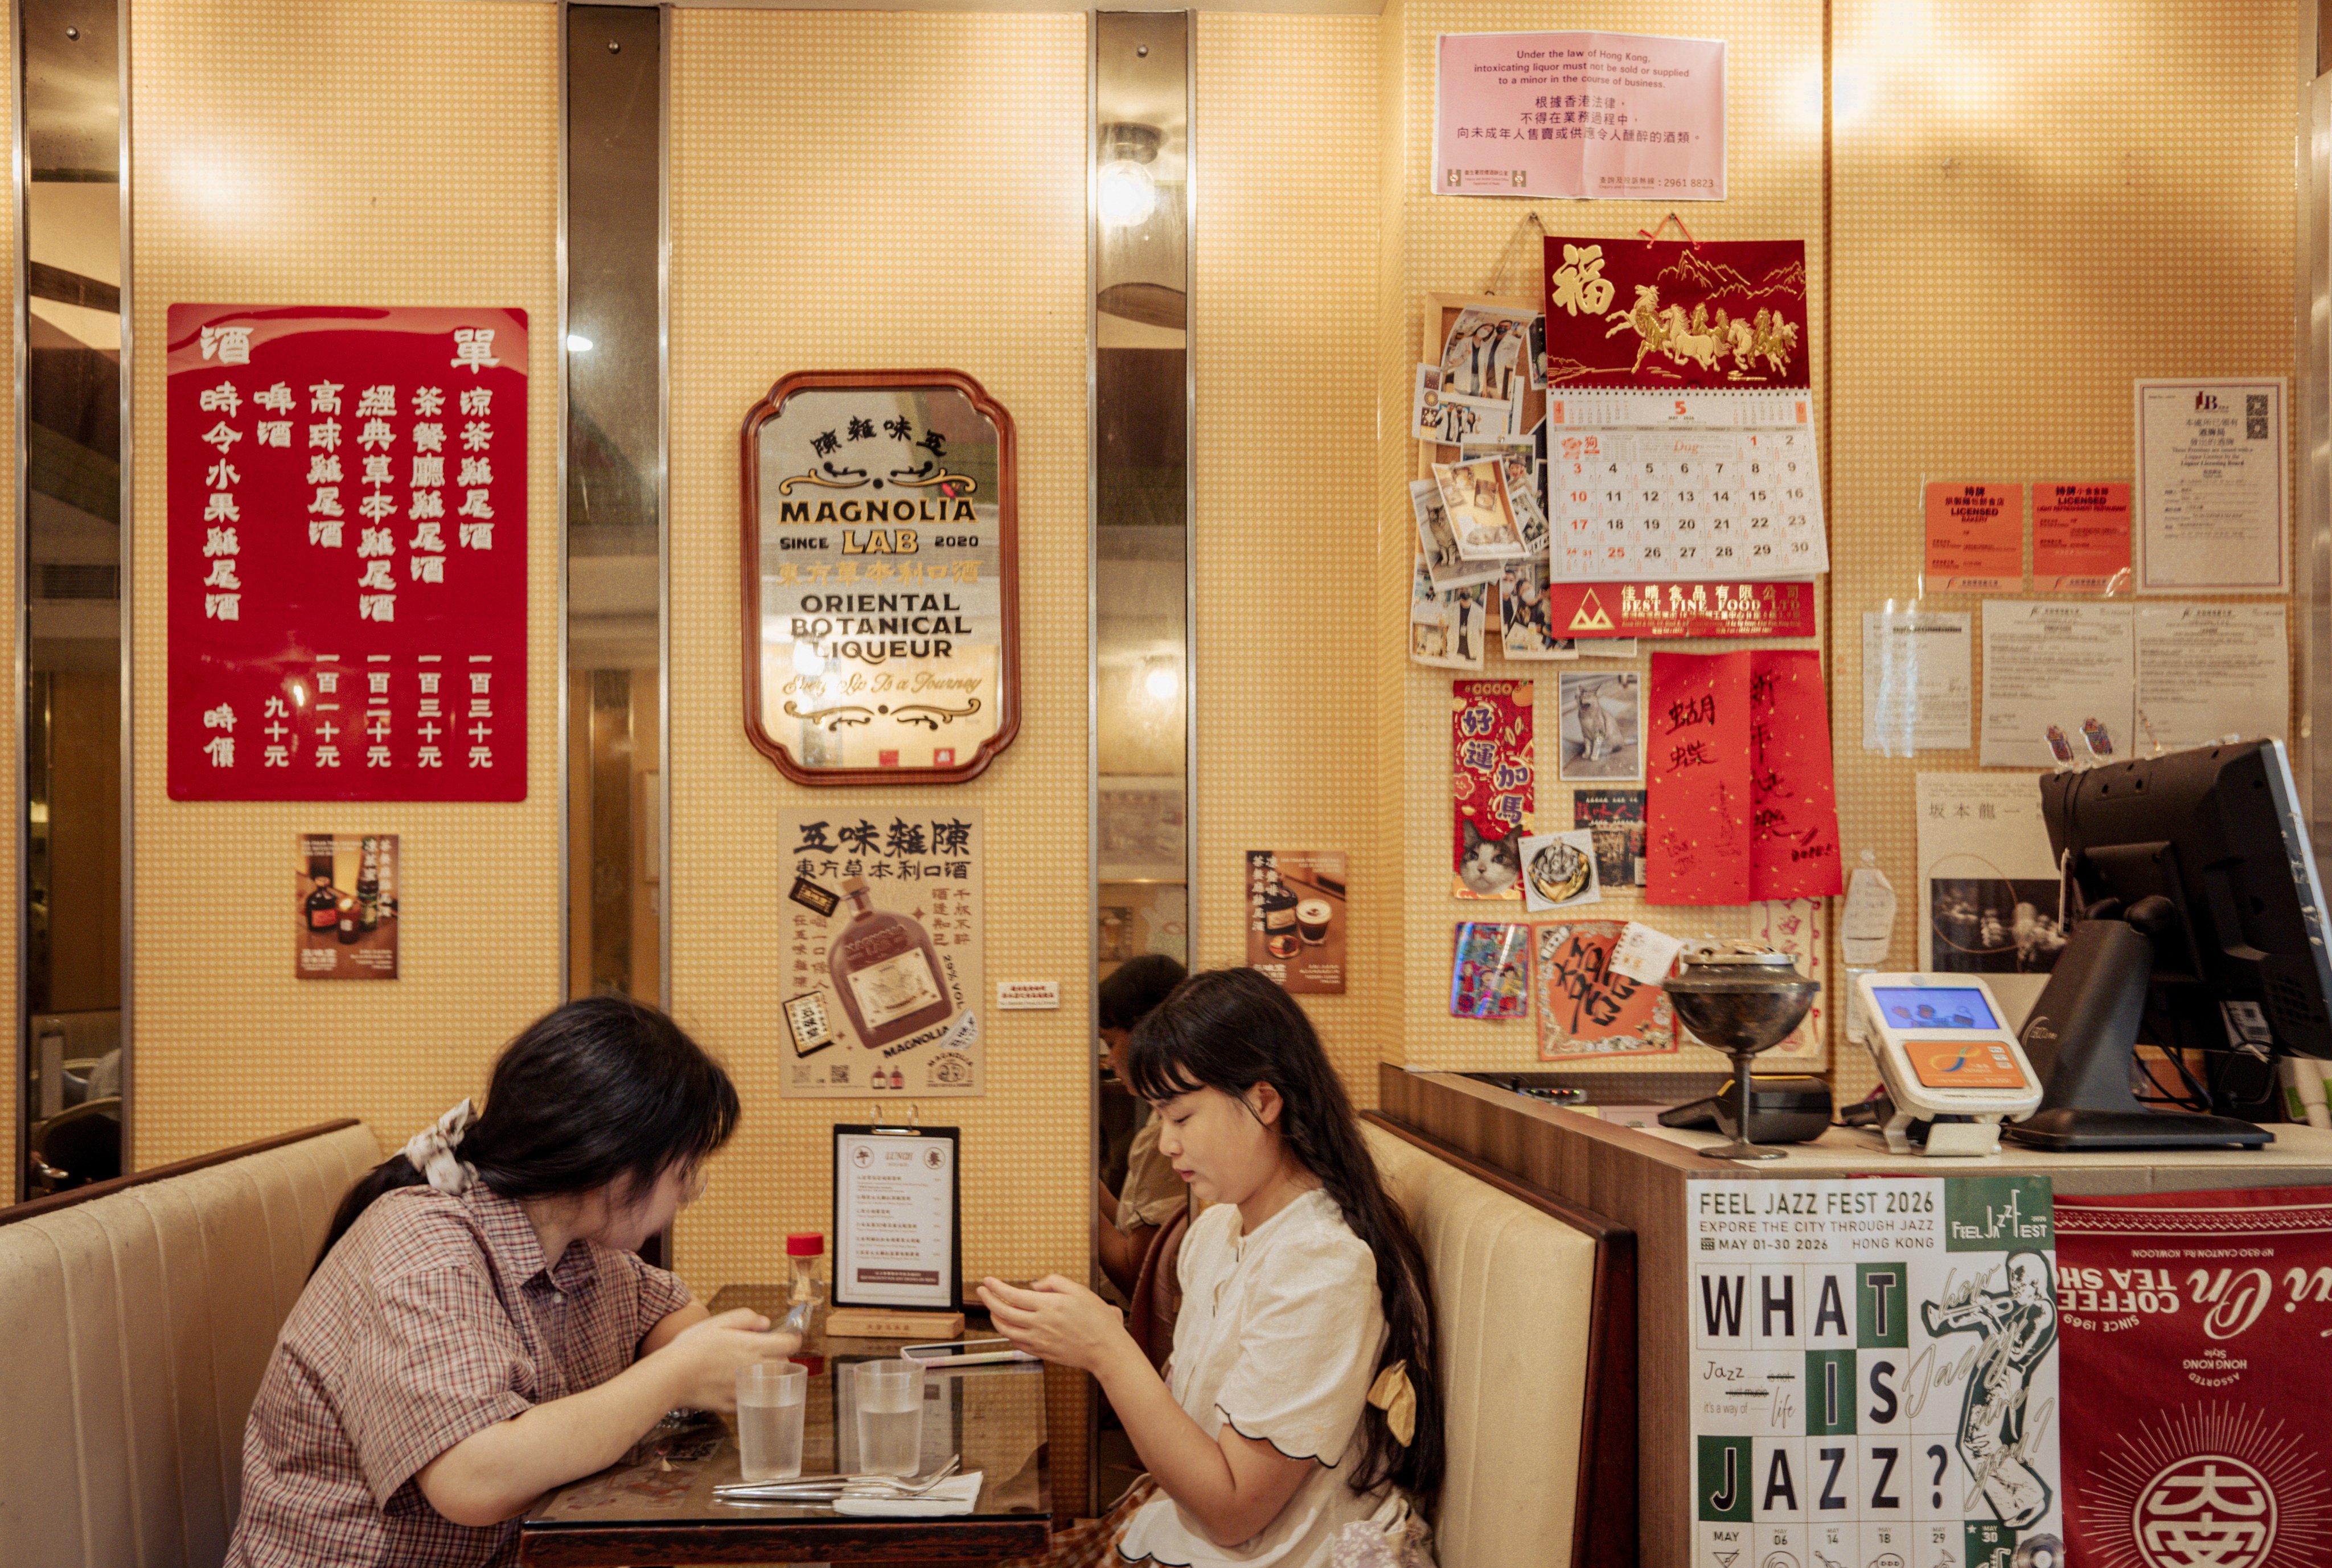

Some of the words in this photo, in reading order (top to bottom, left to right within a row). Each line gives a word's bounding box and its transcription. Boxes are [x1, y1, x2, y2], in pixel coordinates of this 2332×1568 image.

[1517, 50, 1545, 59] Under
[1549, 49, 1563, 58] the
[1567, 49, 1583, 58] law
[1588, 49, 1596, 58] of
[1600, 50, 1622, 62] Hong
[1625, 52, 1651, 64] Kong,
[1474, 63, 1530, 73] intoxicating
[1533, 62, 1559, 72] liquor
[1607, 63, 1617, 72] be
[1620, 64, 1638, 74] sold
[1653, 67, 1689, 77] supplied
[1520, 75, 1547, 84] minor
[1551, 75, 1559, 84] in
[1580, 76, 1610, 85] course
[1613, 76, 1622, 85] of
[1624, 79, 1665, 89] business.
[1664, 179, 1687, 187] 2961
[1690, 179, 1714, 188] 8823
[1552, 244, 1615, 317] 福
[200, 325, 254, 364] 酒
[450, 328, 500, 374] 單
[254, 381, 296, 448] 啤酒
[1674, 400, 1687, 415] 5
[1584, 434, 1598, 449] 狗
[1750, 435, 1757, 446] 1
[1785, 435, 1794, 445] 2
[306, 379, 344, 548] 高球雞尾酒
[1573, 462, 1582, 474] 3
[1608, 462, 1617, 474] 4
[1645, 462, 1654, 474] 5
[1681, 462, 1689, 474] 6
[1715, 463, 1724, 474] 7
[1751, 462, 1760, 474] 8
[1787, 462, 1796, 473] 9
[408, 386, 447, 584] 茶餐廳雞尾酒
[1570, 491, 1587, 502] 10
[1606, 491, 1621, 501] 11
[1643, 491, 1659, 502] 12
[1678, 491, 1694, 502] 13
[1713, 491, 1729, 502] 14
[1750, 490, 1766, 501] 15
[1786, 488, 1804, 499] 16
[356, 384, 398, 622] 經典草本雞尾酒
[779, 496, 979, 524] MAGNOLIA
[1951, 507, 1999, 516] LICENSED
[780, 537, 829, 550] SINCE
[841, 529, 919, 555] LAB
[935, 536, 979, 548] 2020
[775, 560, 984, 587] 東方草本利口酒
[800, 593, 961, 613] ORIENTAL
[1623, 599, 1661, 611] BEST
[1672, 600, 1707, 611] FINE
[1718, 599, 1762, 611] FOOD
[1771, 599, 1800, 611] LTD
[790, 615, 972, 637] BOTANICAL
[812, 639, 953, 666] LIQUEUR
[896, 679, 908, 689] a
[911, 672, 982, 694] Journey
[315, 654, 340, 768] 一百一十元
[367, 654, 392, 768] 一百二十元
[418, 654, 442, 768] 一百三十元
[469, 654, 493, 768] 一百三十元
[203, 703, 237, 768] 時價
[264, 696, 289, 768] 九十元
[793, 816, 972, 858] 五味雜陳
[796, 857, 972, 881] 東方草本利口酒
[951, 982, 965, 1010] VOL
[882, 1025, 950, 1058] MAGNOLIA
[1699, 1193, 1756, 1215] FEEL
[1764, 1193, 1818, 1215] JAZZ
[1827, 1192, 1879, 1214] FEST
[1887, 1192, 1935, 1214] 2026
[1699, 1221, 1758, 1232] EXPORE
[1763, 1221, 1789, 1232] THE
[1795, 1221, 1825, 1232] CITY
[1832, 1221, 1895, 1232] THROUGH
[1900, 1220, 1935, 1231] JAZZ
[1718, 1239, 1747, 1250] MAY
[1752, 1238, 1791, 1250] 01-30
[1796, 1238, 1828, 1250] 2026
[1852, 1238, 1890, 1249] HONG
[1895, 1237, 1935, 1249] KONG
[2132, 1248, 2181, 1258] KOWLOON
[2183, 1249, 2196, 1258] Rd.
[2197, 1248, 2237, 1258] CANTON
[2239, 1248, 2260, 1258] 830
[2108, 1268, 2178, 1291] TEA
[1701, 1273, 1896, 1337] WHAT
[2057, 1290, 2179, 1314] COFFEE
[2062, 1313, 2096, 1331] 1969
[2103, 1313, 2140, 1332] SINCE
[2183, 1358, 2214, 1369] KONG
[2203, 1348, 2227, 1359] Style
[2215, 1358, 2248, 1369] HONG
[1703, 1361, 1745, 1381] Jazz
[2188, 1372, 2240, 1387] ASSORTED
[1825, 1361, 1898, 1426] IS
[1704, 1402, 1715, 1414] it's
[1717, 1405, 1722, 1414] a
[1723, 1405, 1739, 1417] way
[1740, 1402, 1748, 1414] of
[1771, 1386, 1797, 1429] life
[1709, 1444, 1948, 1512] JAZZ?
[1713, 1530, 1740, 1543] MAY
[1773, 1535, 1788, 1545] 06
[1826, 1534, 1840, 1545] 14
[1879, 1533, 1892, 1544] 18
[1932, 1533, 1946, 1544] 29
[1981, 1532, 1998, 1544] 30
